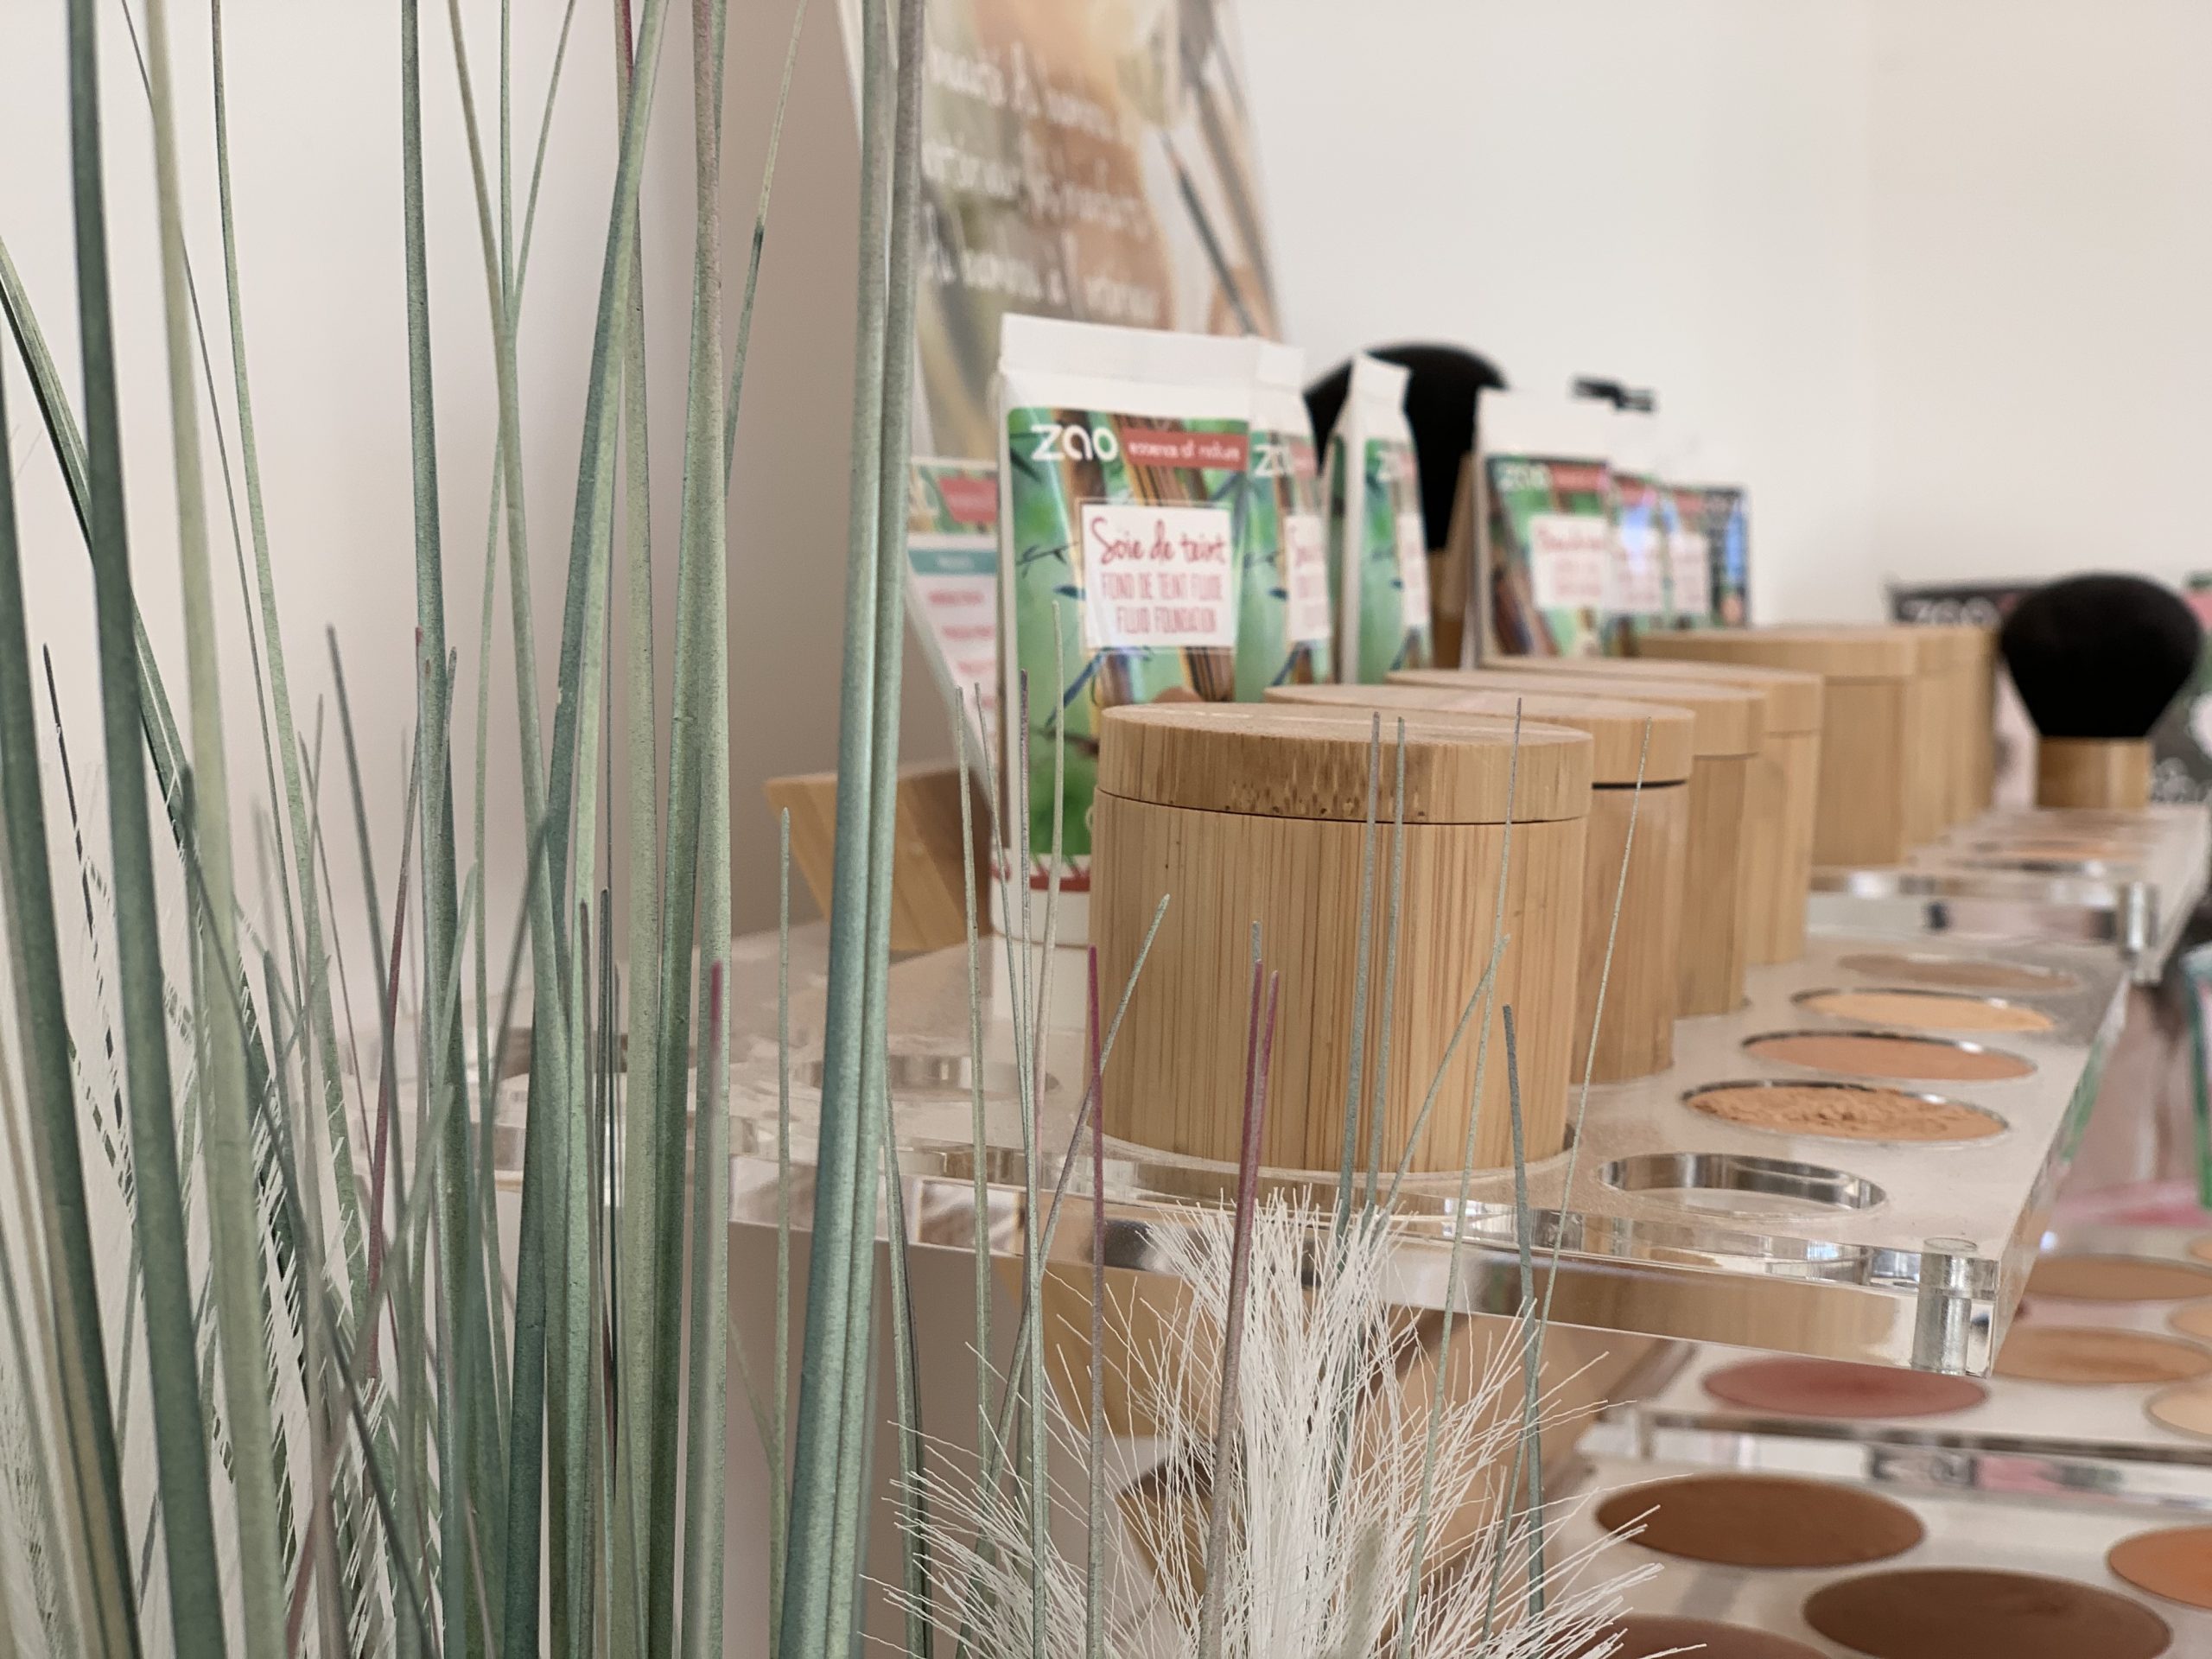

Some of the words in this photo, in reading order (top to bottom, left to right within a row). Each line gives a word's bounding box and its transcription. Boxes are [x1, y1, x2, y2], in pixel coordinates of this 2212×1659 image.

[1031, 424, 1118, 461] zao
[1090, 516, 1144, 564] Soie
[1150, 518, 1175, 560] de
[1180, 531, 1225, 564] teint
